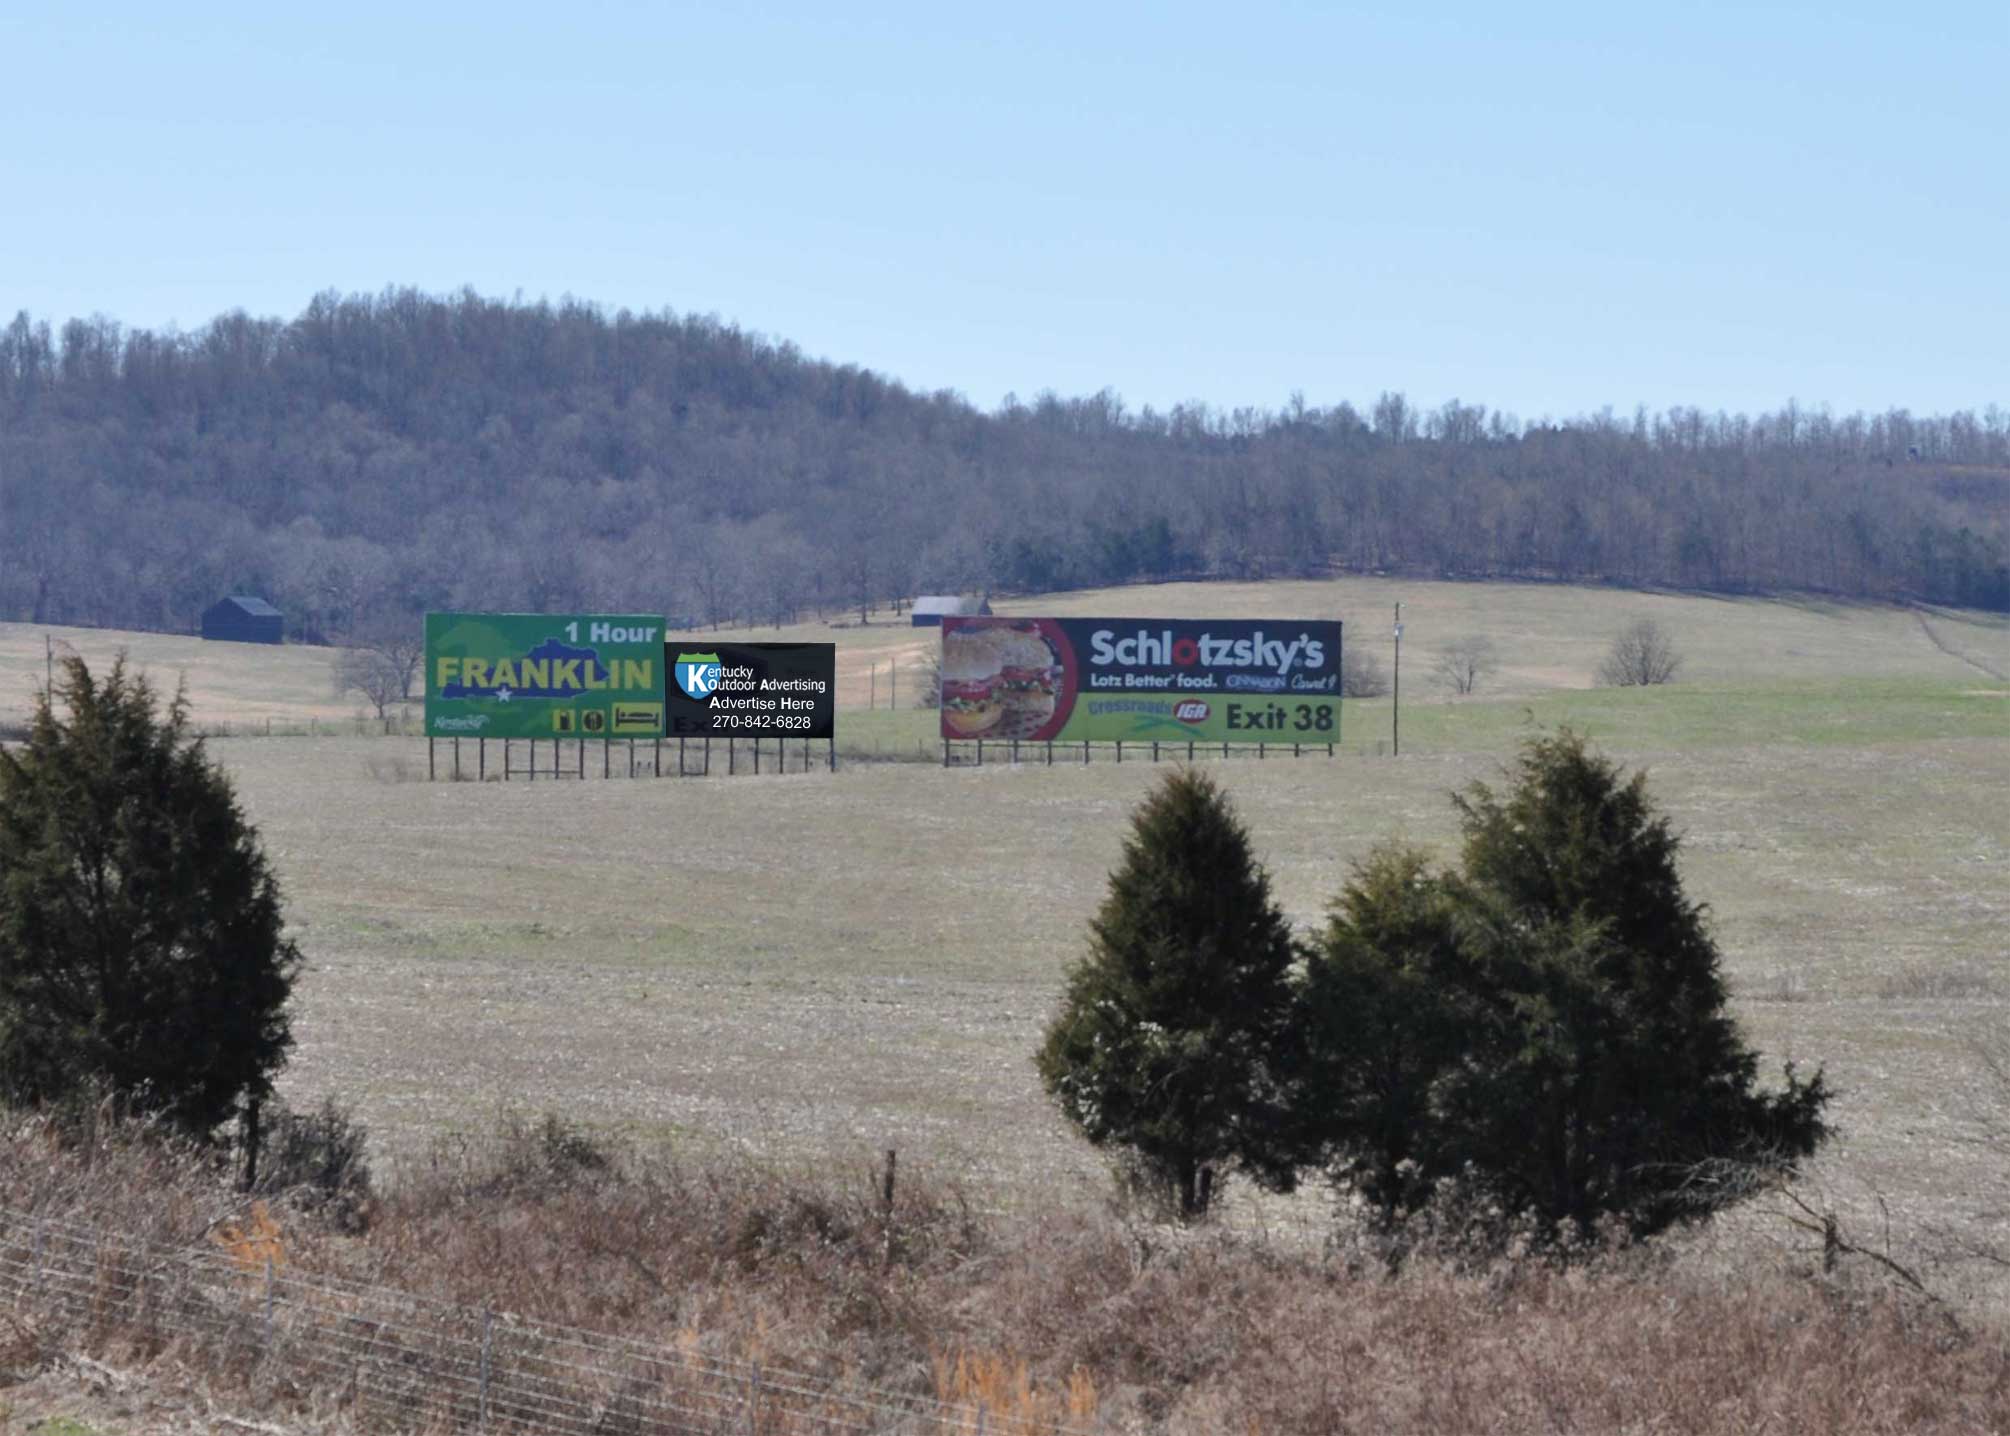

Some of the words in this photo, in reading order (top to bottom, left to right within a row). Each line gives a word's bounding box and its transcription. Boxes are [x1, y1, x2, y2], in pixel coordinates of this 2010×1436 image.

[565, 622, 579, 642] 1
[590, 622, 657, 643] Hour
[1090, 629, 1325, 674] Schlotzsky's
[436, 656, 653, 689] FRANKLIN
[687, 664, 754, 692] Kentucky
[1090, 673, 1123, 688] Lotz
[1125, 673, 1171, 688] Better
[1177, 673, 1219, 689] food.
[707, 679, 757, 692] Outdoor
[760, 678, 826, 694] Advertising
[709, 696, 776, 711] Advertise
[780, 697, 815, 710] Here
[712, 715, 812, 729] 270-842-6828
[1227, 703, 1288, 730] Exit
[1294, 703, 1334, 731] 38
